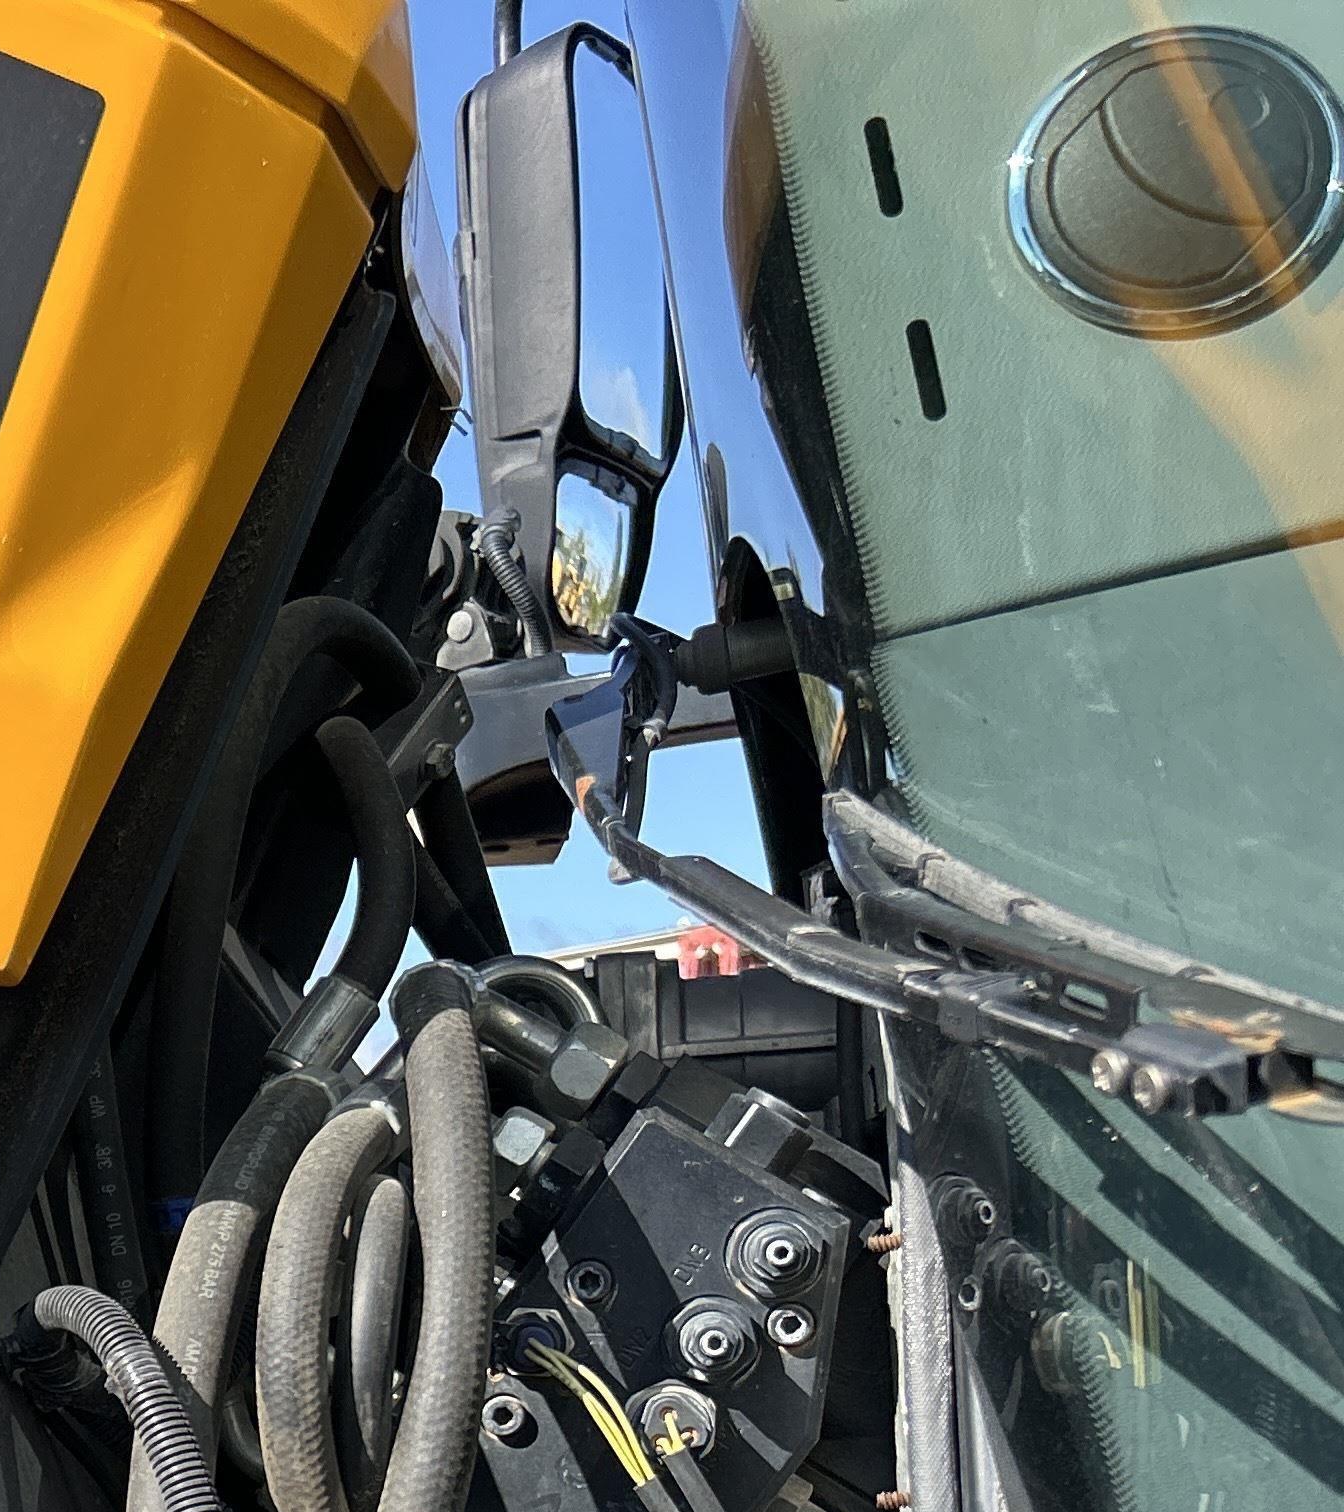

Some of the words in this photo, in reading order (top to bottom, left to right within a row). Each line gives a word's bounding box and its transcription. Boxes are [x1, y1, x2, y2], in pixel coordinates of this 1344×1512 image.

[104, 1211, 123, 1230] 10
[108, 1233, 128, 1256] DN
[205, 1241, 227, 1268] 275
